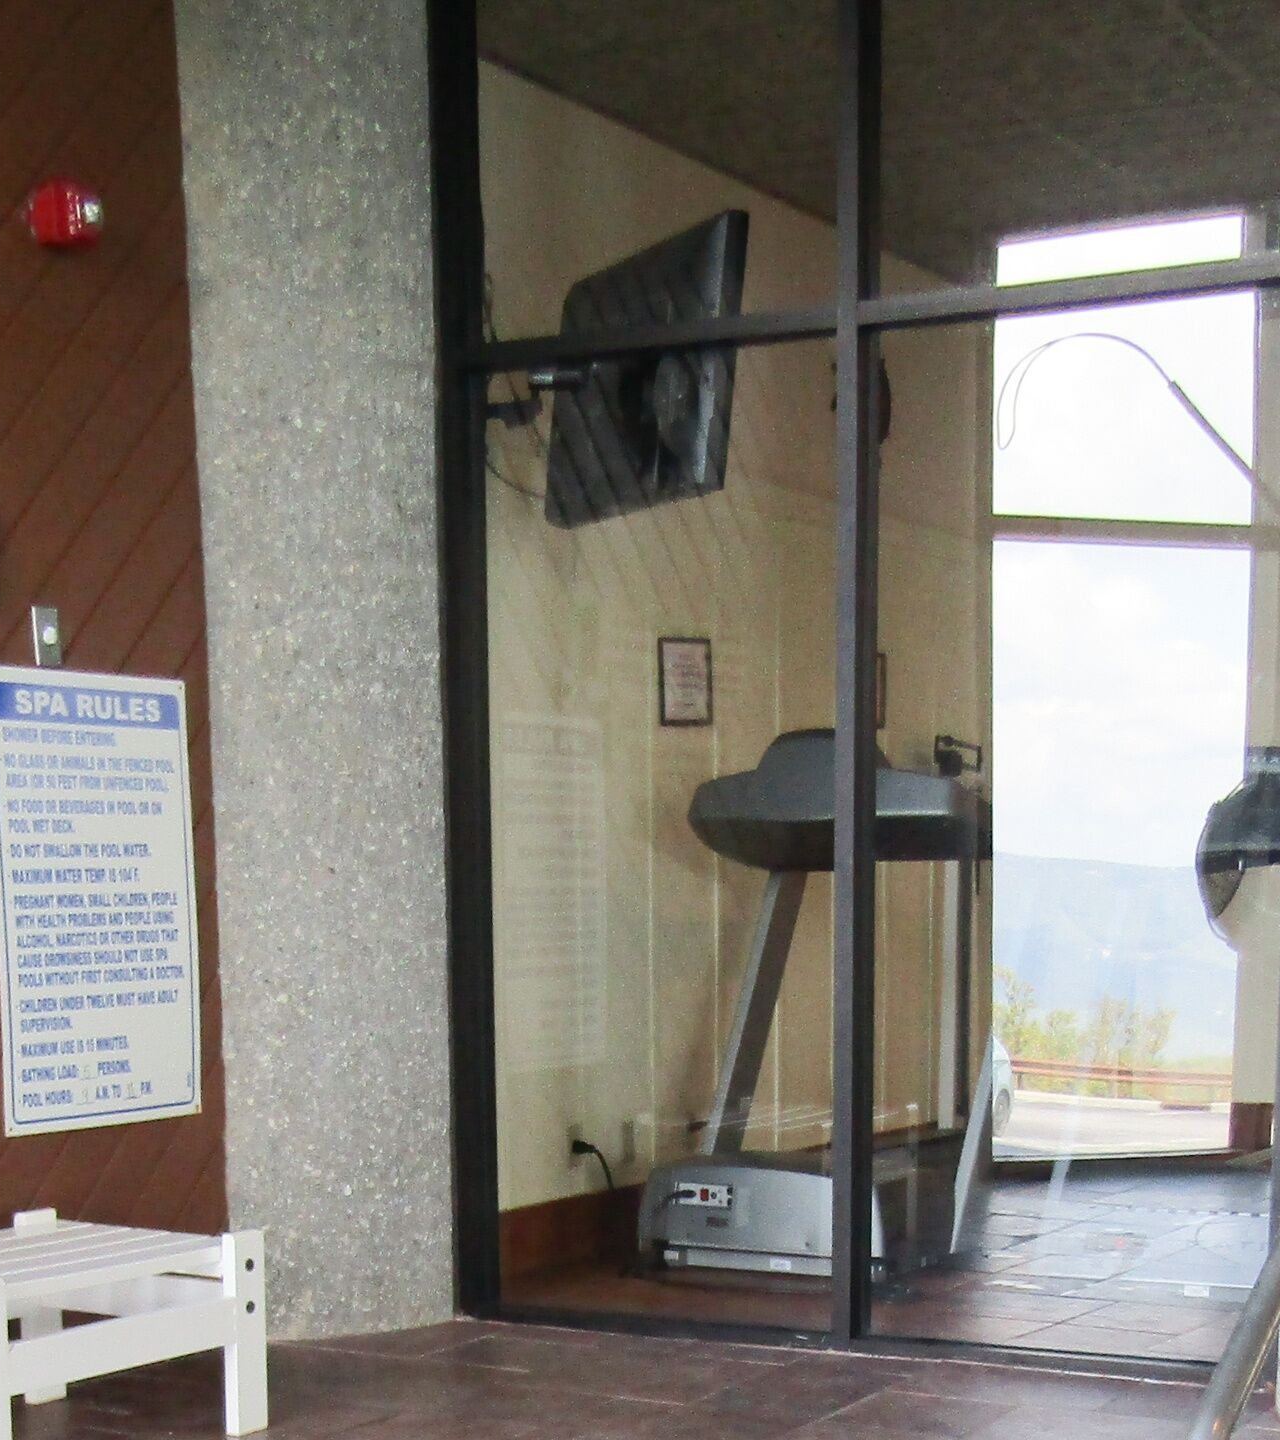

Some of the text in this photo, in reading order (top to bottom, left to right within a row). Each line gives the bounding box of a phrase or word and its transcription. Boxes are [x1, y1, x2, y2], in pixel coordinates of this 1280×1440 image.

[15, 689, 161, 722] SPA RULES
[3, 728, 37, 743] SHOWER
[41, 729, 73, 744] BEFORE
[4, 754, 174, 773] NO GLASS OR ANIMALS IN THE FENCED POOL
[6, 774, 27, 788] AREA
[58, 776, 76, 789] FEET
[80, 776, 100, 790] FROM
[103, 777, 143, 792] UNFENCED
[7, 800, 162, 815] NO FOOD OR BEVERAGES IN POOL OR ON
[9, 819, 29, 833] POOL
[32, 819, 49, 833] WET
[10, 844, 152, 858] DO NOT SWALLOW THE POOL WATER.
[12, 869, 52, 884] MAXIMUM
[56, 869, 81, 883] WATER
[109, 869, 116, 882] IS
[14, 895, 53, 909] PREGNANT
[88, 894, 111, 907] SMALL
[151, 892, 177, 906] PEOPLE
[16, 911, 175, 928] WITH HEALTH PROBLEMS AND PEOPLE USING
[56, 932, 97, 947] NARCOTICS
[100, 932, 109, 945] OR
[112, 931, 134, 944] OTHER
[136, 930, 159, 943] DRUGS
[162, 929, 179, 942] THAT
[18, 948, 168, 968] CAUSE DROWSINESS SHOULD NOT USE SPA
[18, 973, 43, 988] POOLS
[45, 972, 79, 986] WITHOUT
[81, 970, 102, 984] FIRST
[104, 968, 148, 983] CONSULTING
[150, 967, 155, 980] A
[20, 990, 179, 1013] CHILDREN UNDER TWELVE MUST HAVE ADULT
[21, 1041, 57, 1057] MAXIMUM
[61, 1040, 75, 1054] USE
[77, 1039, 83, 1053] IS
[86, 1038, 94, 1052] 15
[22, 1066, 56, 1083] BATHING
[23, 1093, 42, 1108] POOL
[112, 1084, 121, 1099] TO
